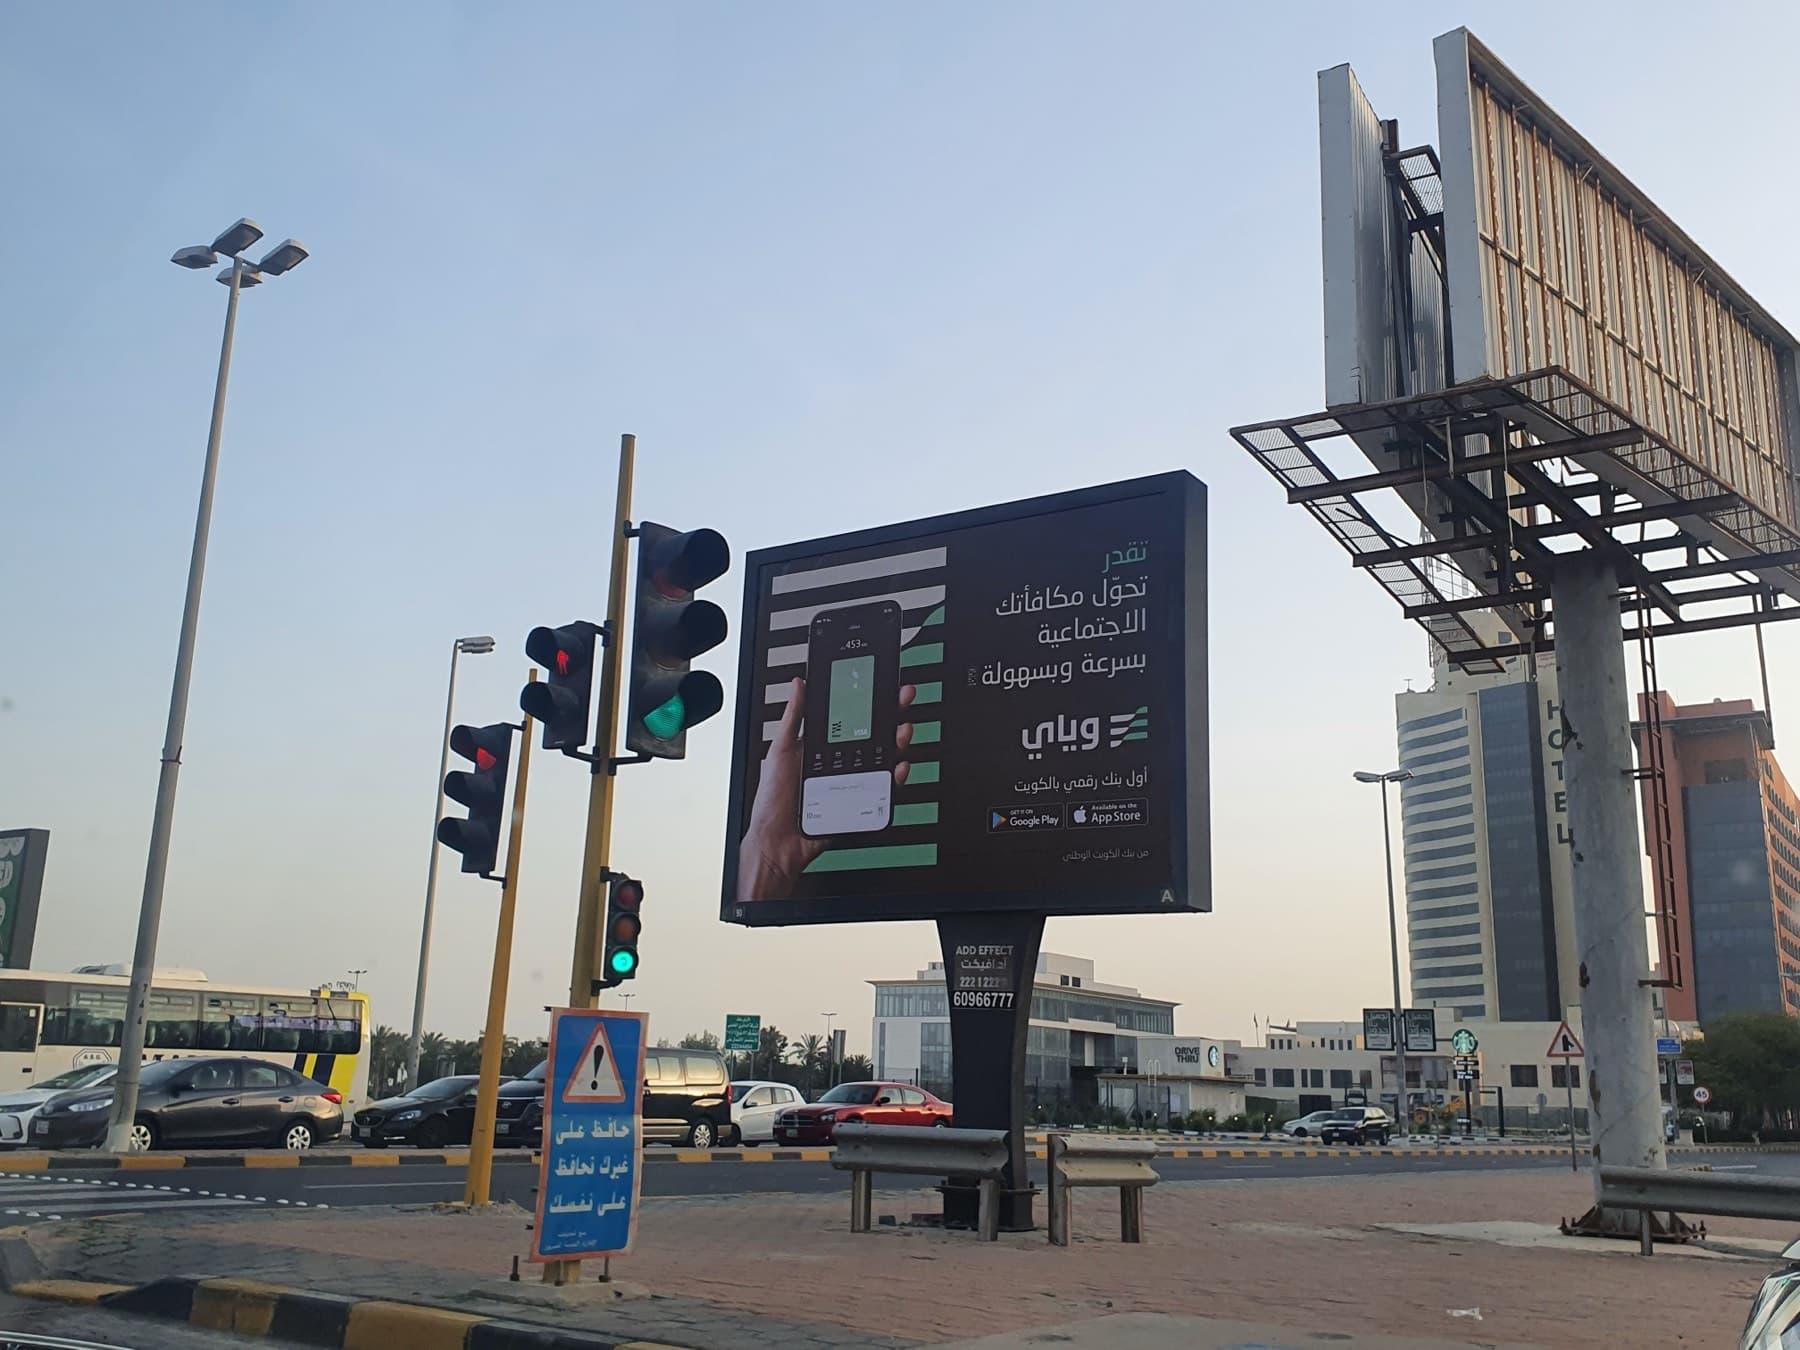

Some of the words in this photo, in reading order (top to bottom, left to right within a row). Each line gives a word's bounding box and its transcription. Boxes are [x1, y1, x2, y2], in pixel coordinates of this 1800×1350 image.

[1101, 541, 1149, 573] تقدر
[995, 584, 1084, 616] مكافأتك
[1038, 608, 1146, 649] الاجتماعية
[981, 661, 1072, 690] وبسهولة
[1081, 652, 1147, 679] بسرعة
[1021, 714, 1100, 761] وياي
[1101, 771, 1122, 788] بنك
[1126, 765, 1147, 788] أول
[1547, 699, 1570, 845] HOTEL
[1014, 776, 1060, 795] بالكويت
[1063, 774, 1098, 794] رقمي
[1009, 815, 1041, 828] Google
[1041, 814, 1059, 826] Play
[1091, 812, 1113, 825] App
[1113, 811, 1141, 822] Store
[1160, 889, 1174, 903] A
[955, 945, 977, 955] ADD
[978, 945, 1014, 956] EFFECT
[953, 991, 1014, 1008] 60966777
[1175, 1046, 1200, 1055] DRIVE
[1177, 1055, 1199, 1063] THRU
[555, 1119, 585, 1145] على
[590, 1116, 630, 1139] حافظ
[599, 1153, 629, 1180] غيرك
[549, 1191, 594, 1214] نفسك
[597, 1191, 627, 1217] على
